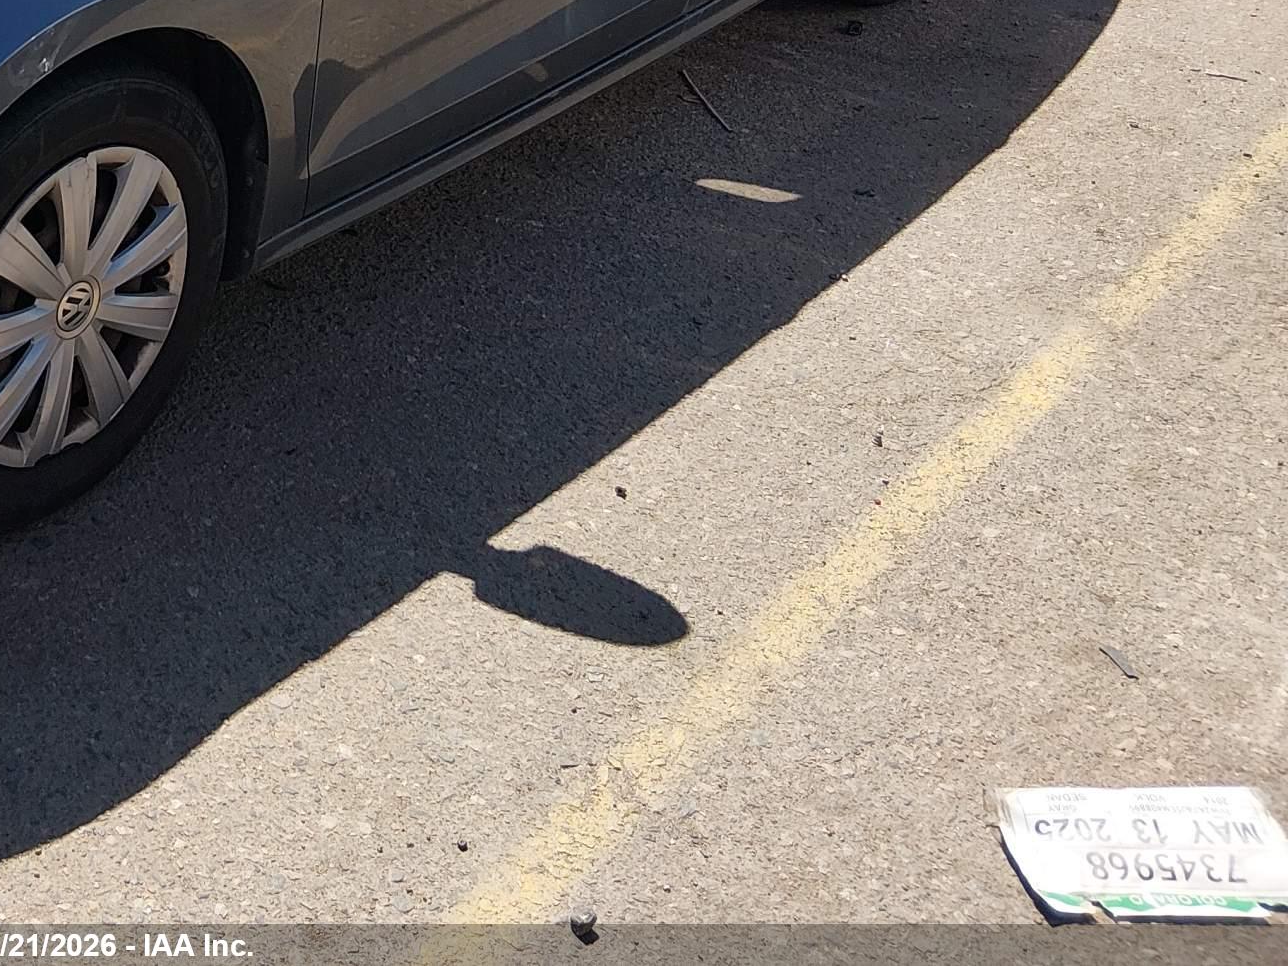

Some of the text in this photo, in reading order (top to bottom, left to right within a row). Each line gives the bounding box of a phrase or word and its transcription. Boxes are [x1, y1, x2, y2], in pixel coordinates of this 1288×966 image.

[1034, 817, 1265, 845] MAY 13 2025
[1086, 851, 1248, 884] 7345968
